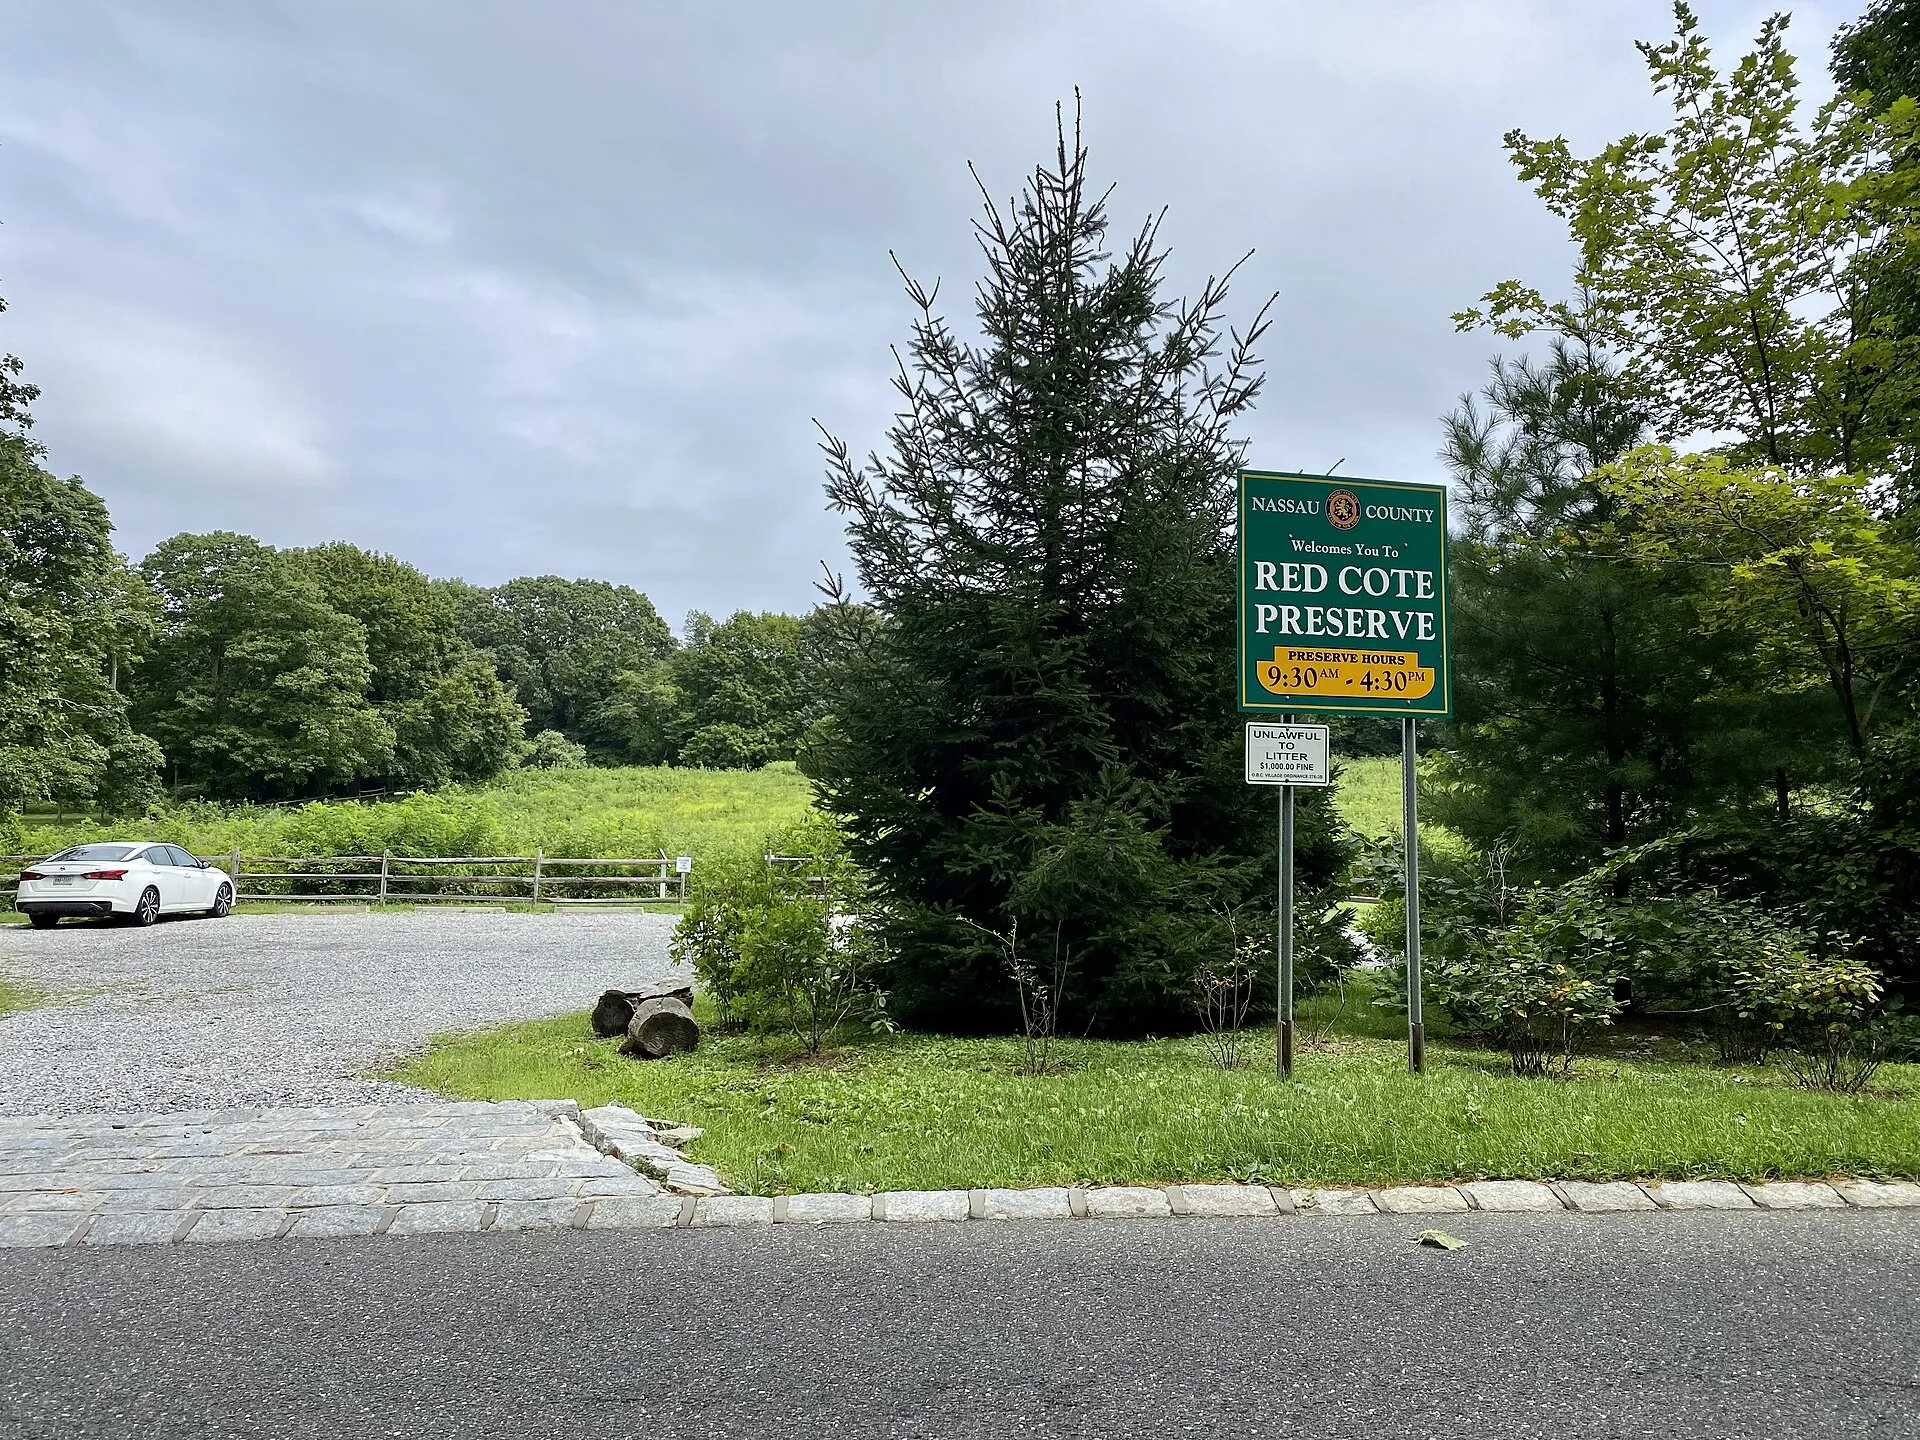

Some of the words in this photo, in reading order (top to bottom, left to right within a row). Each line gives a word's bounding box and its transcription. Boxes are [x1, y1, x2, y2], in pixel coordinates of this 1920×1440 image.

[1251, 496, 1320, 515] NASSAU
[1365, 505, 1434, 523] COUNTY
[1291, 539, 1352, 555] Welcomes
[1355, 543, 1379, 557] You
[1382, 545, 1399, 558] To
[1254, 561, 1328, 593] RED
[1338, 566, 1435, 599] COTE
[1254, 604, 1436, 641] PRESERVE
[1288, 651, 1358, 663] PRESERVE
[1362, 654, 1405, 665] HOURS
[1253, 730, 1321, 741] UNLAWFUL
[1278, 742, 1295, 750] TO
[1265, 752, 1308, 761] LITTER
[1260, 762, 1295, 771] $1,000.00
[1296, 763, 1314, 771] FINE
